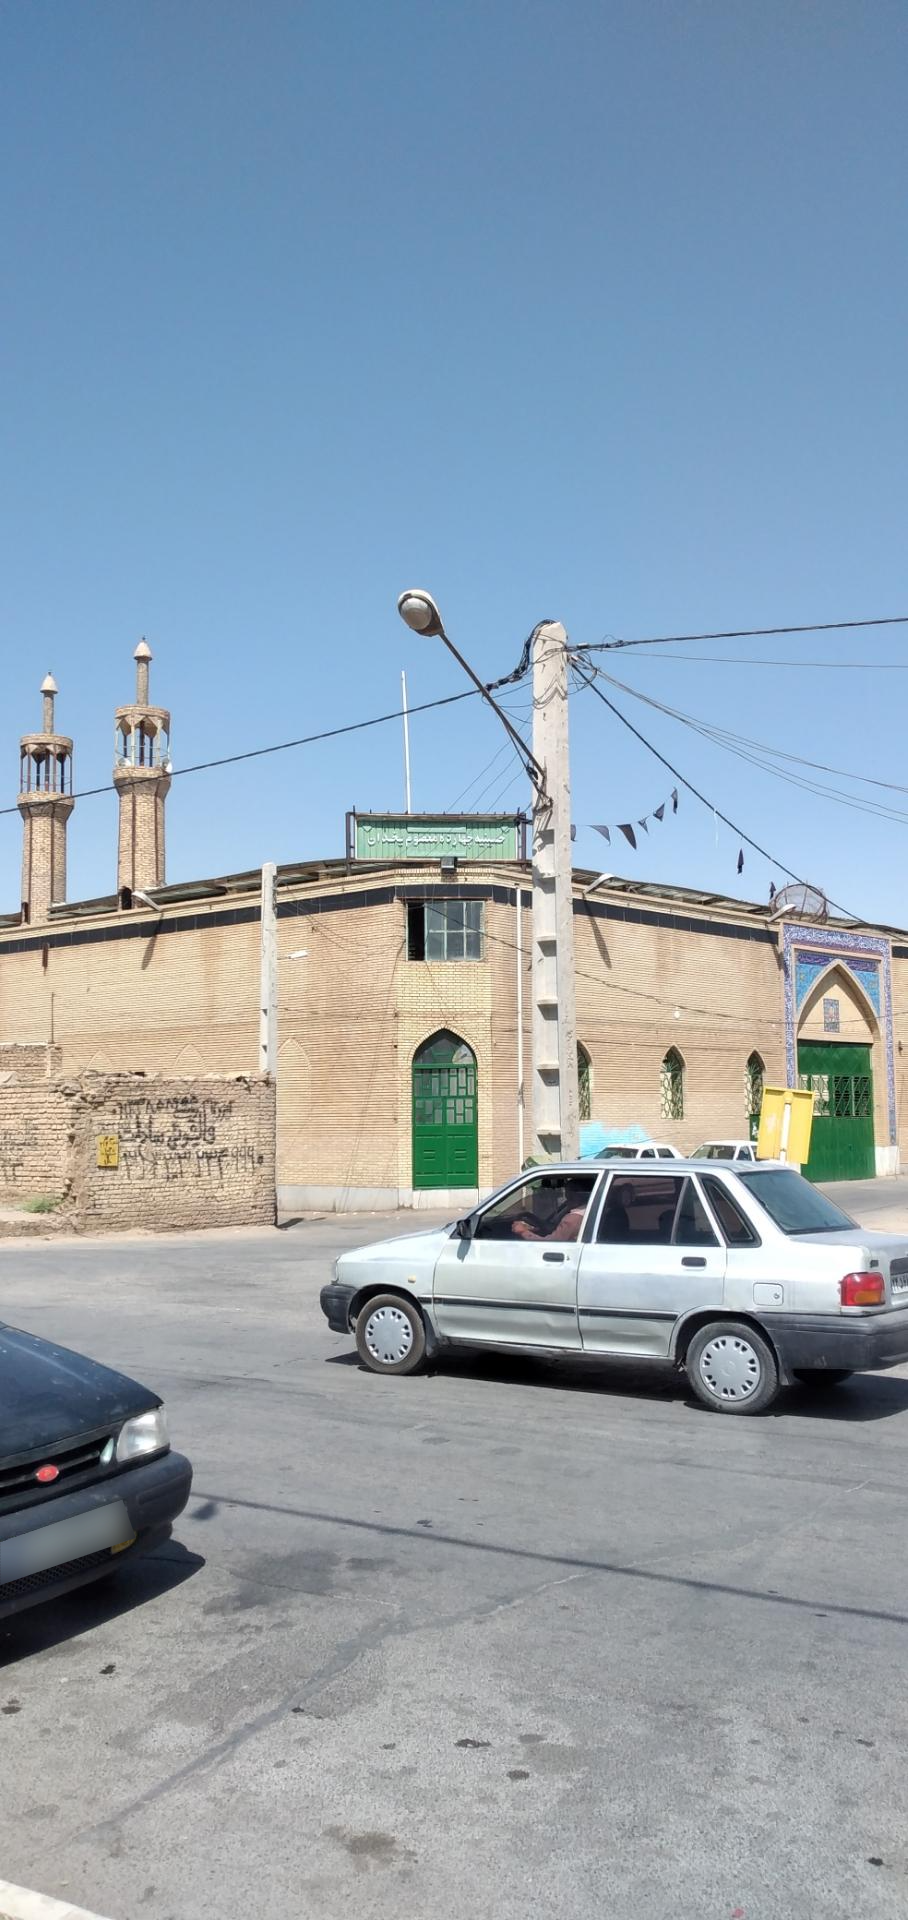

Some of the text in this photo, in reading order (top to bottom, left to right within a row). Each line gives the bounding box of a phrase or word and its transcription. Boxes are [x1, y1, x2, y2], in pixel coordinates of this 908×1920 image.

[406, 834, 438, 848] معصوم
[440, 833, 474, 849] چهارده
[474, 832, 506, 848] حسینیه
